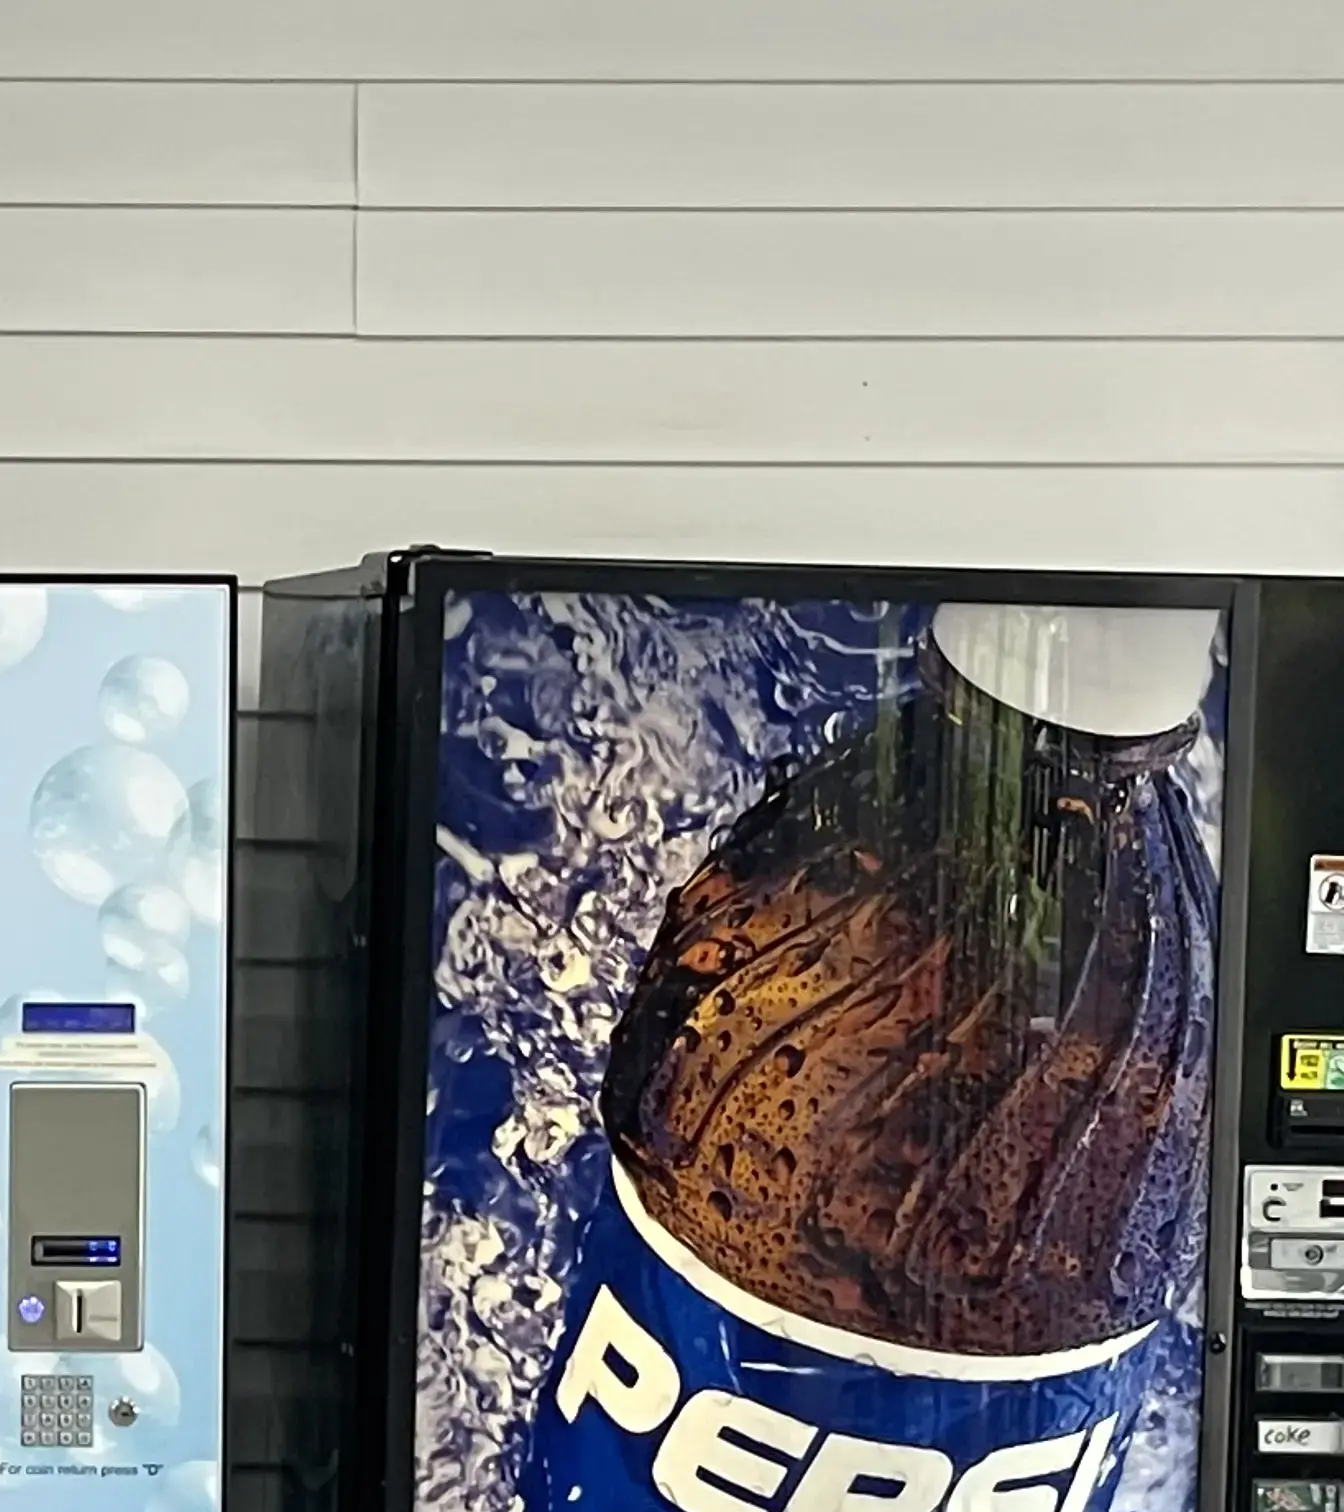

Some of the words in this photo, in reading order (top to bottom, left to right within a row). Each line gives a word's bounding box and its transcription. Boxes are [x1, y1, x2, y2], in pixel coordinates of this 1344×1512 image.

[1264, 1425, 1311, 1446] coke
[0, 1462, 22, 1475] For
[57, 1463, 98, 1475] return
